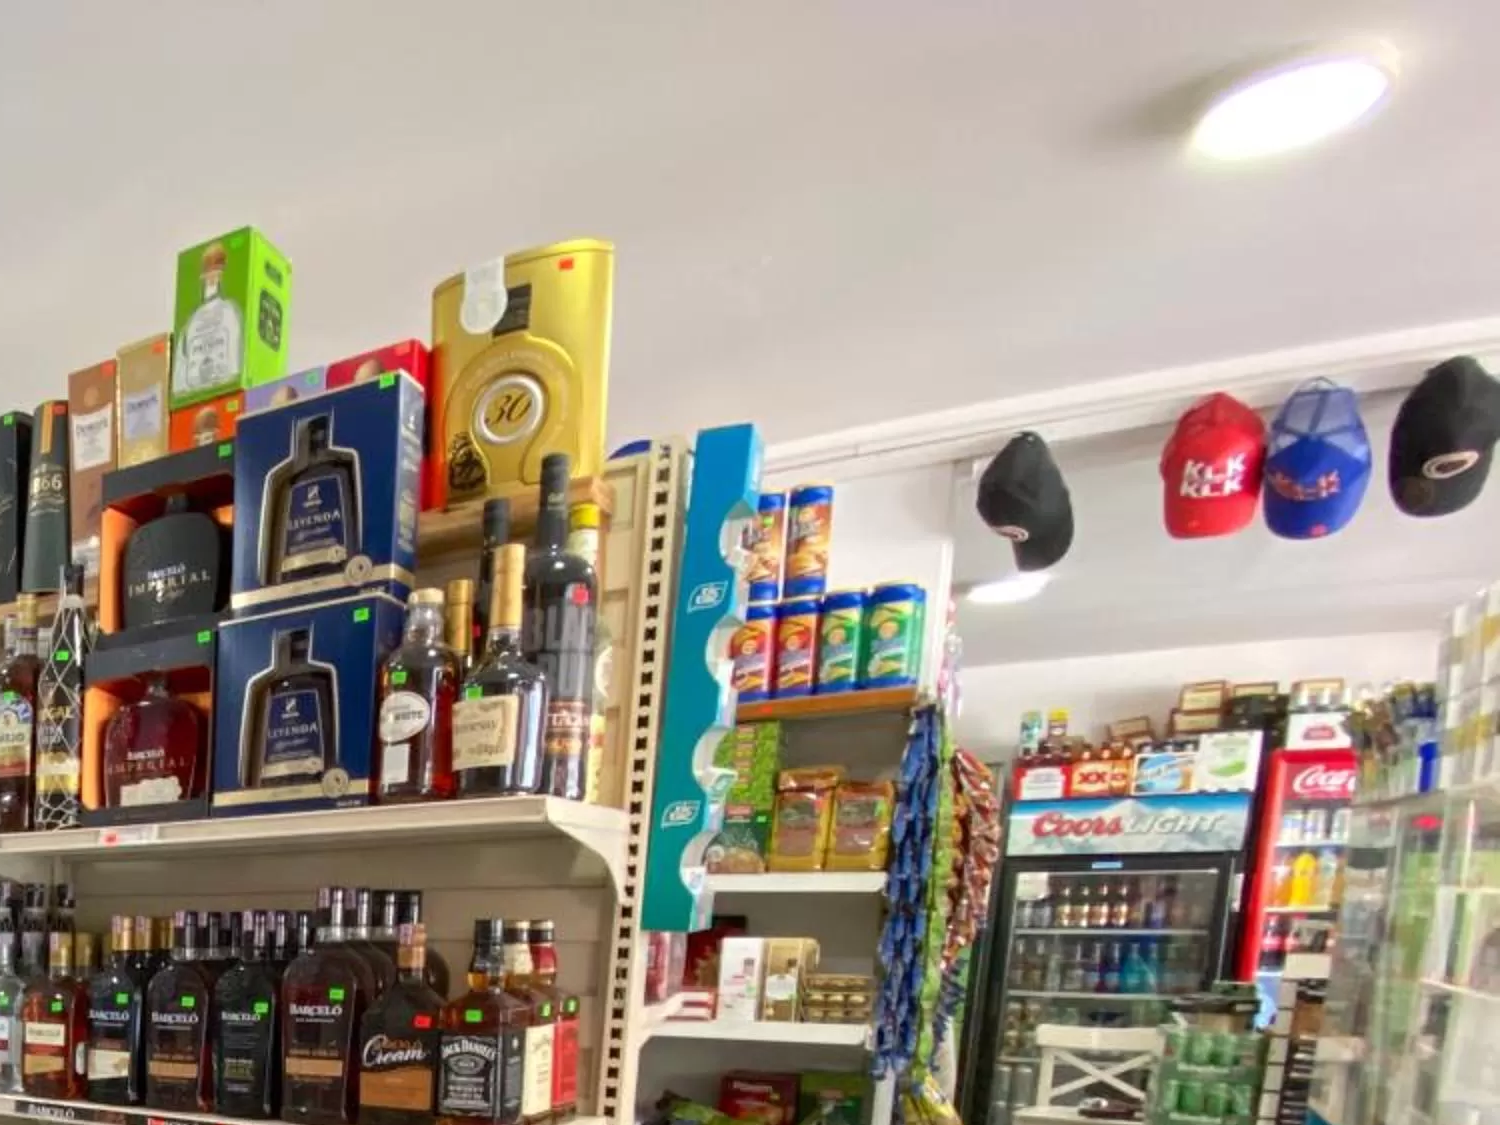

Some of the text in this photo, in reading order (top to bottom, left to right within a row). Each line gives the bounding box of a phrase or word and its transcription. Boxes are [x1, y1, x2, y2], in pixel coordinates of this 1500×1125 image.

[1031, 811, 1227, 839] Coors LIGHT
[362, 1033, 427, 1067] Cream
